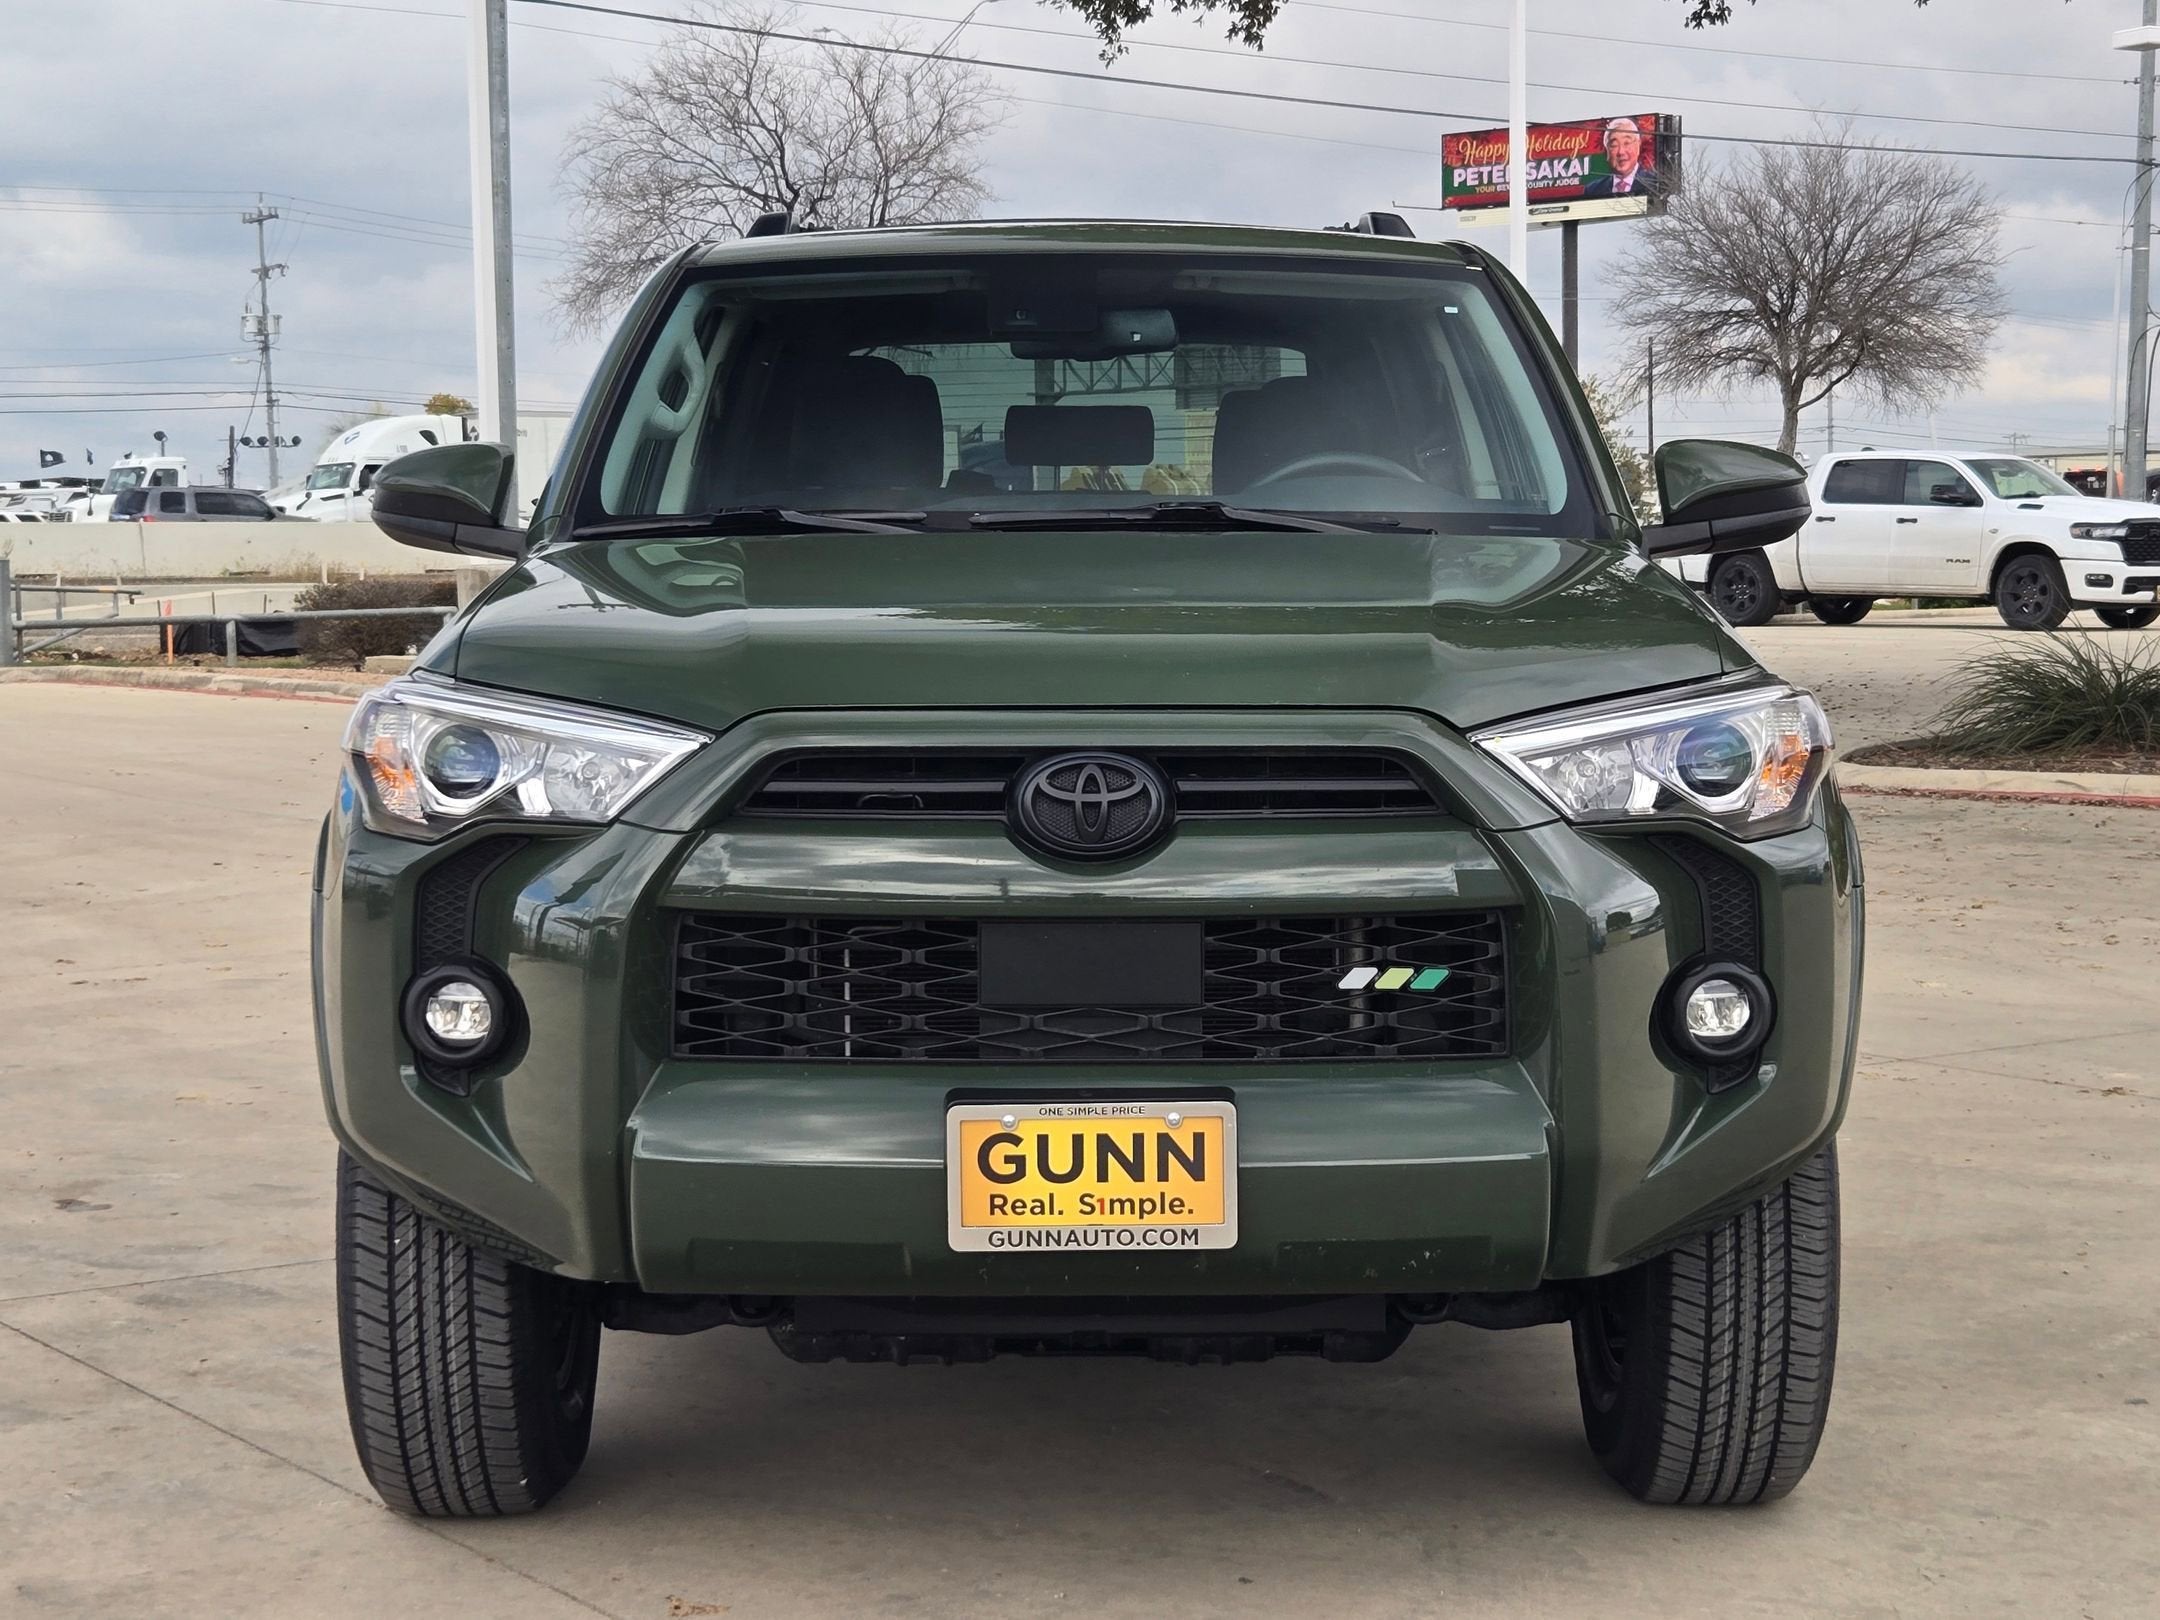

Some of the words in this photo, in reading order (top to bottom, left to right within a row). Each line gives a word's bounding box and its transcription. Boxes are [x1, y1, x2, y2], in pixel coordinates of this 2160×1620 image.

[1526, 157, 1590, 180] SAKAI
[1475, 185, 1496, 194] YOUR
[1527, 180, 1553, 189] OUNTY
[1554, 177, 1580, 187] JUDGE
[1039, 1106, 1064, 1117] ONE
[1066, 1106, 1109, 1116] SIMPLE
[1112, 1105, 1146, 1116] PRICE
[977, 1131, 1206, 1185] GUNN
[989, 1192, 1065, 1216] Real.
[988, 1228, 1200, 1248] GUNNAUTO.COM
